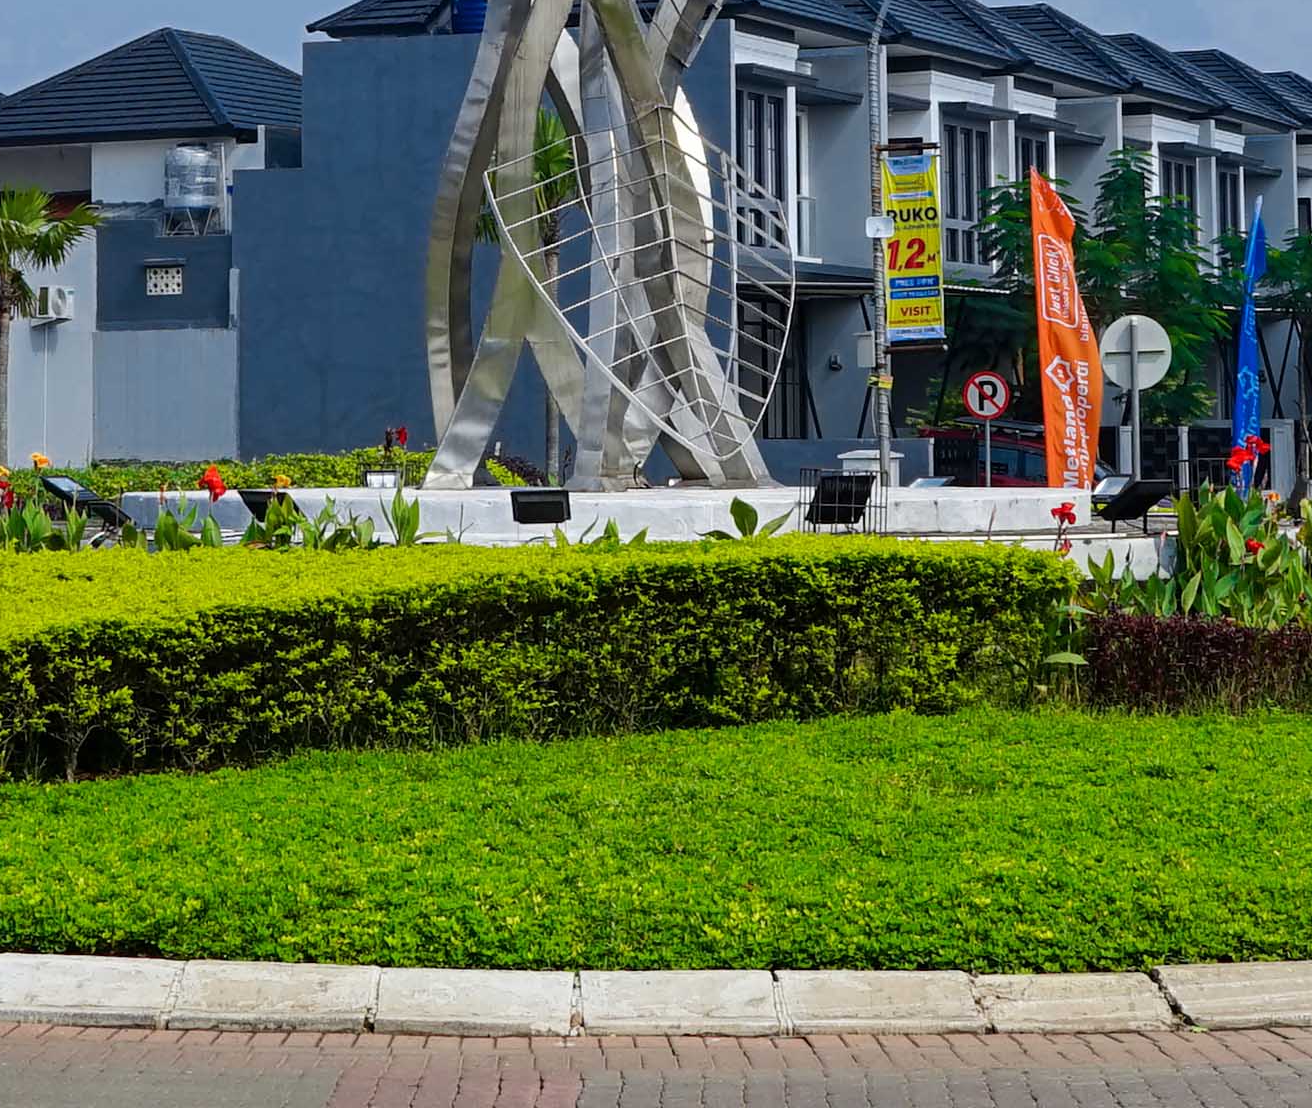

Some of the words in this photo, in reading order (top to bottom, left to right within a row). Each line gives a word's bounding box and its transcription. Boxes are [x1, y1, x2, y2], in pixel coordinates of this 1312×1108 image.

[886, 206, 937, 223] RUKO
[887, 237, 926, 272] 1,2
[900, 305, 931, 317] VISIT
[1049, 287, 1062, 316] Just
[978, 380, 998, 411] P
